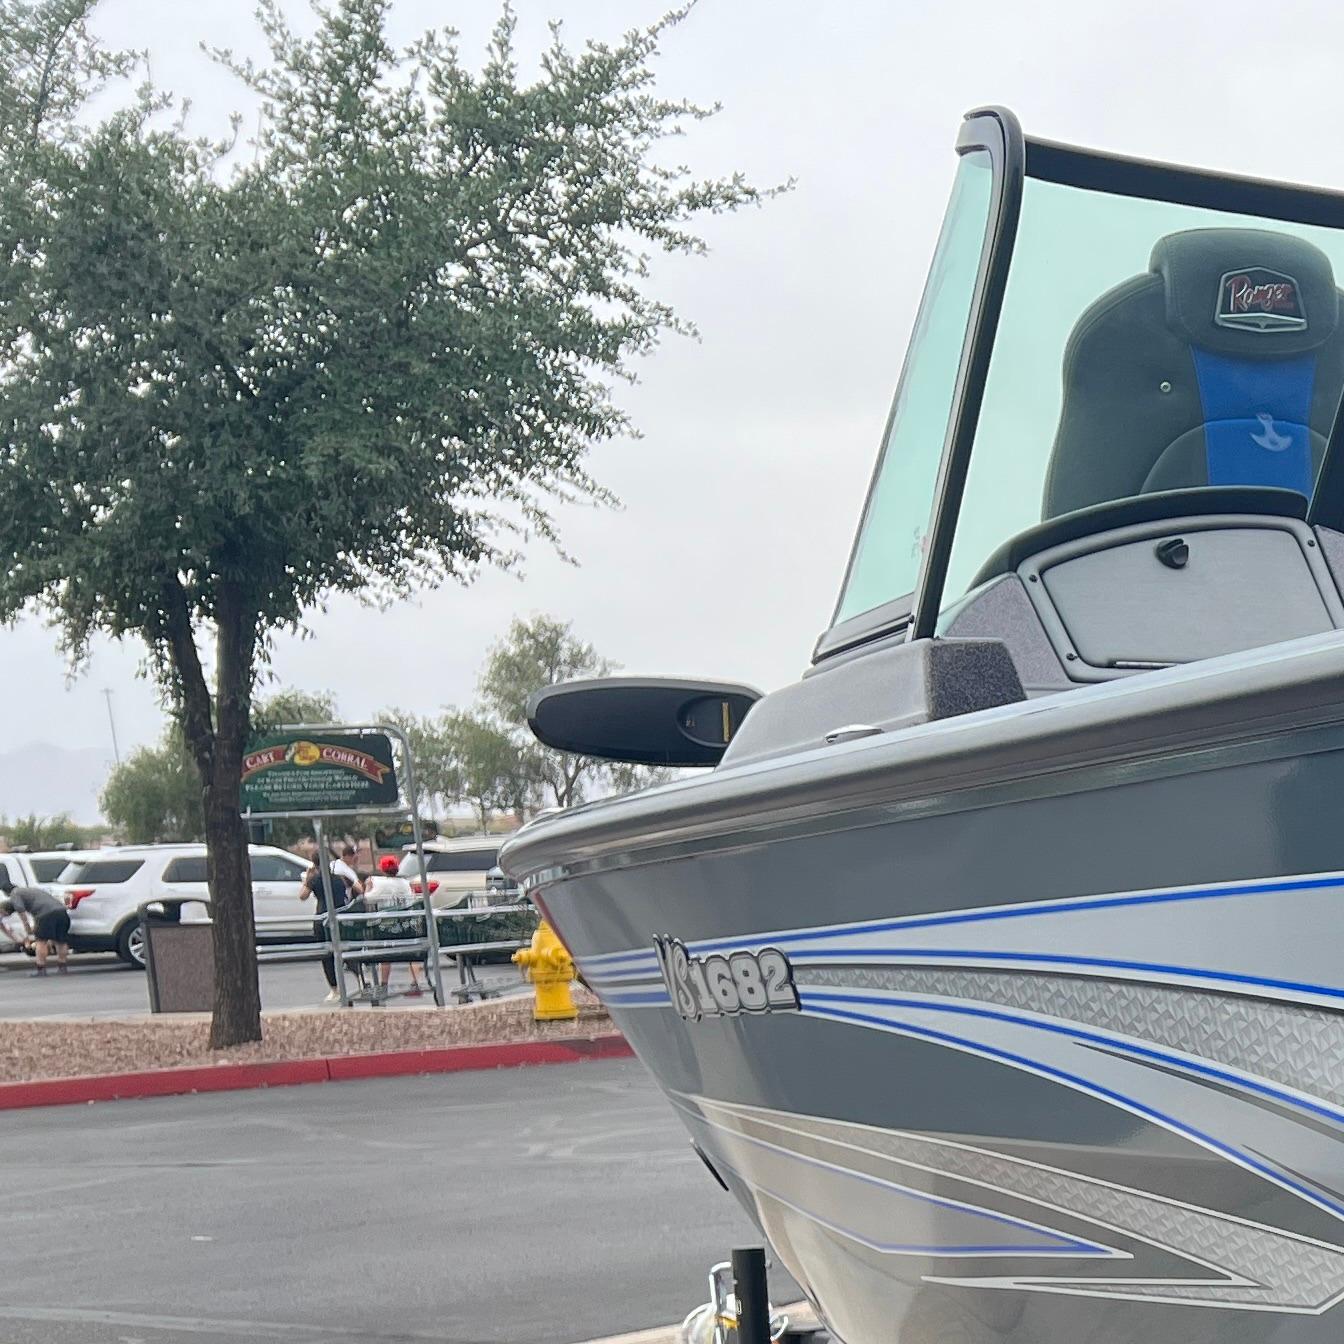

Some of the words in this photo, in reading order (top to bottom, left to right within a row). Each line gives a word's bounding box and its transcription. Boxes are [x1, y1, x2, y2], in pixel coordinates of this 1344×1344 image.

[1226, 275, 1292, 312] Ranger
[245, 751, 275, 769] CART
[322, 748, 369, 770] CORRAL
